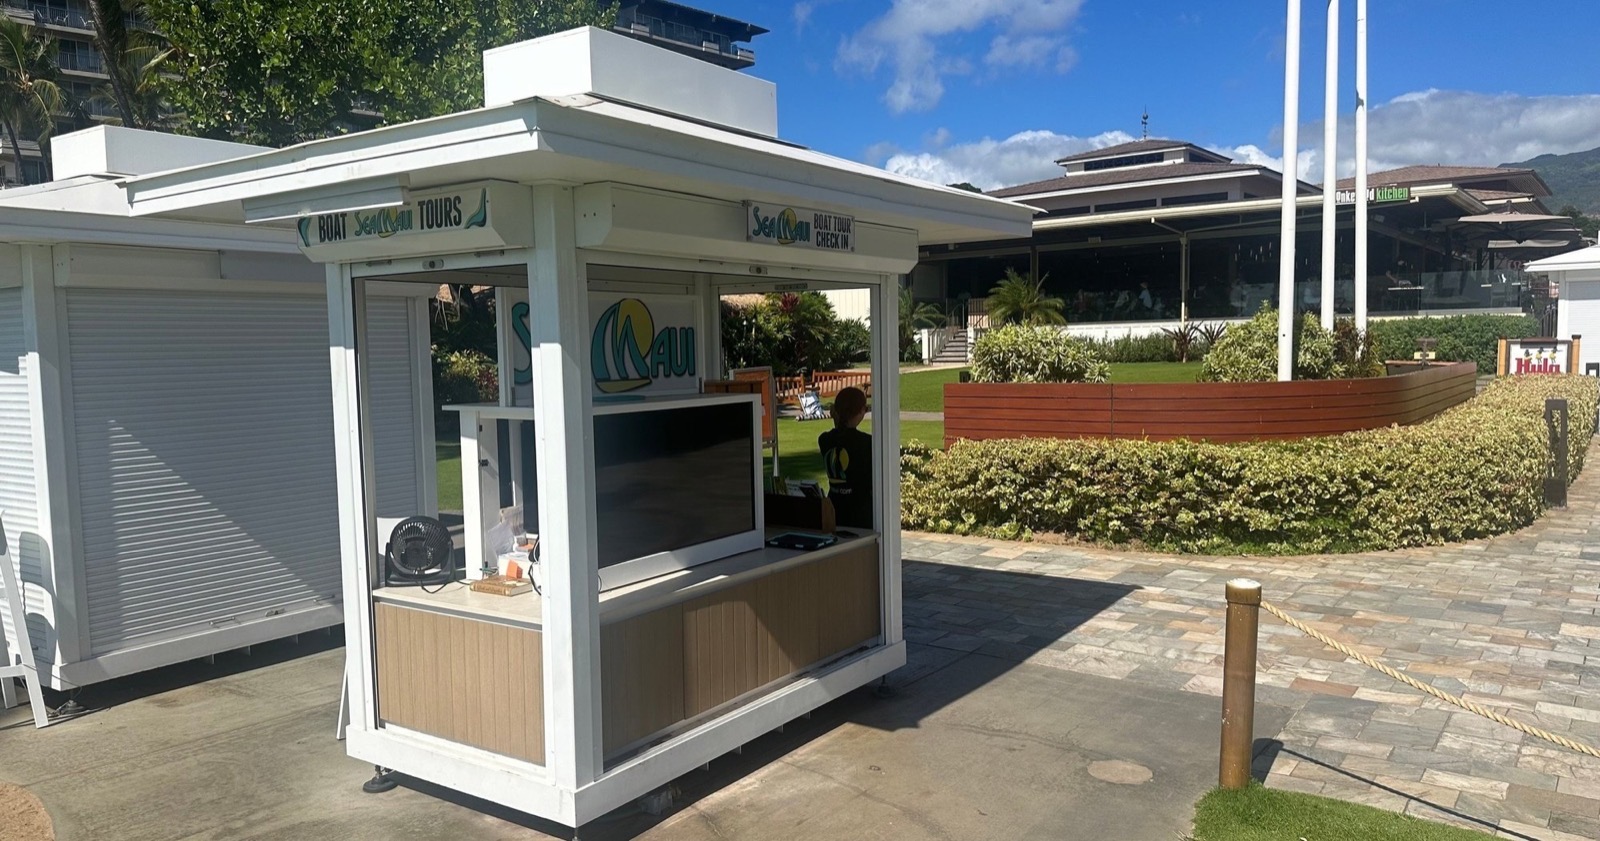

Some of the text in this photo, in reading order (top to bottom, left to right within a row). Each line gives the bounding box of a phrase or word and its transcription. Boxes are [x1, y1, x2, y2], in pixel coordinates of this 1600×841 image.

[1376, 186, 1408, 200] kitchen
[318, 213, 347, 243] BOAT
[418, 196, 462, 230] TOURS
[813, 213, 852, 234] BOAT TOUR
[816, 232, 849, 250] CHECK IN
[1515, 358, 1560, 374] Hula
